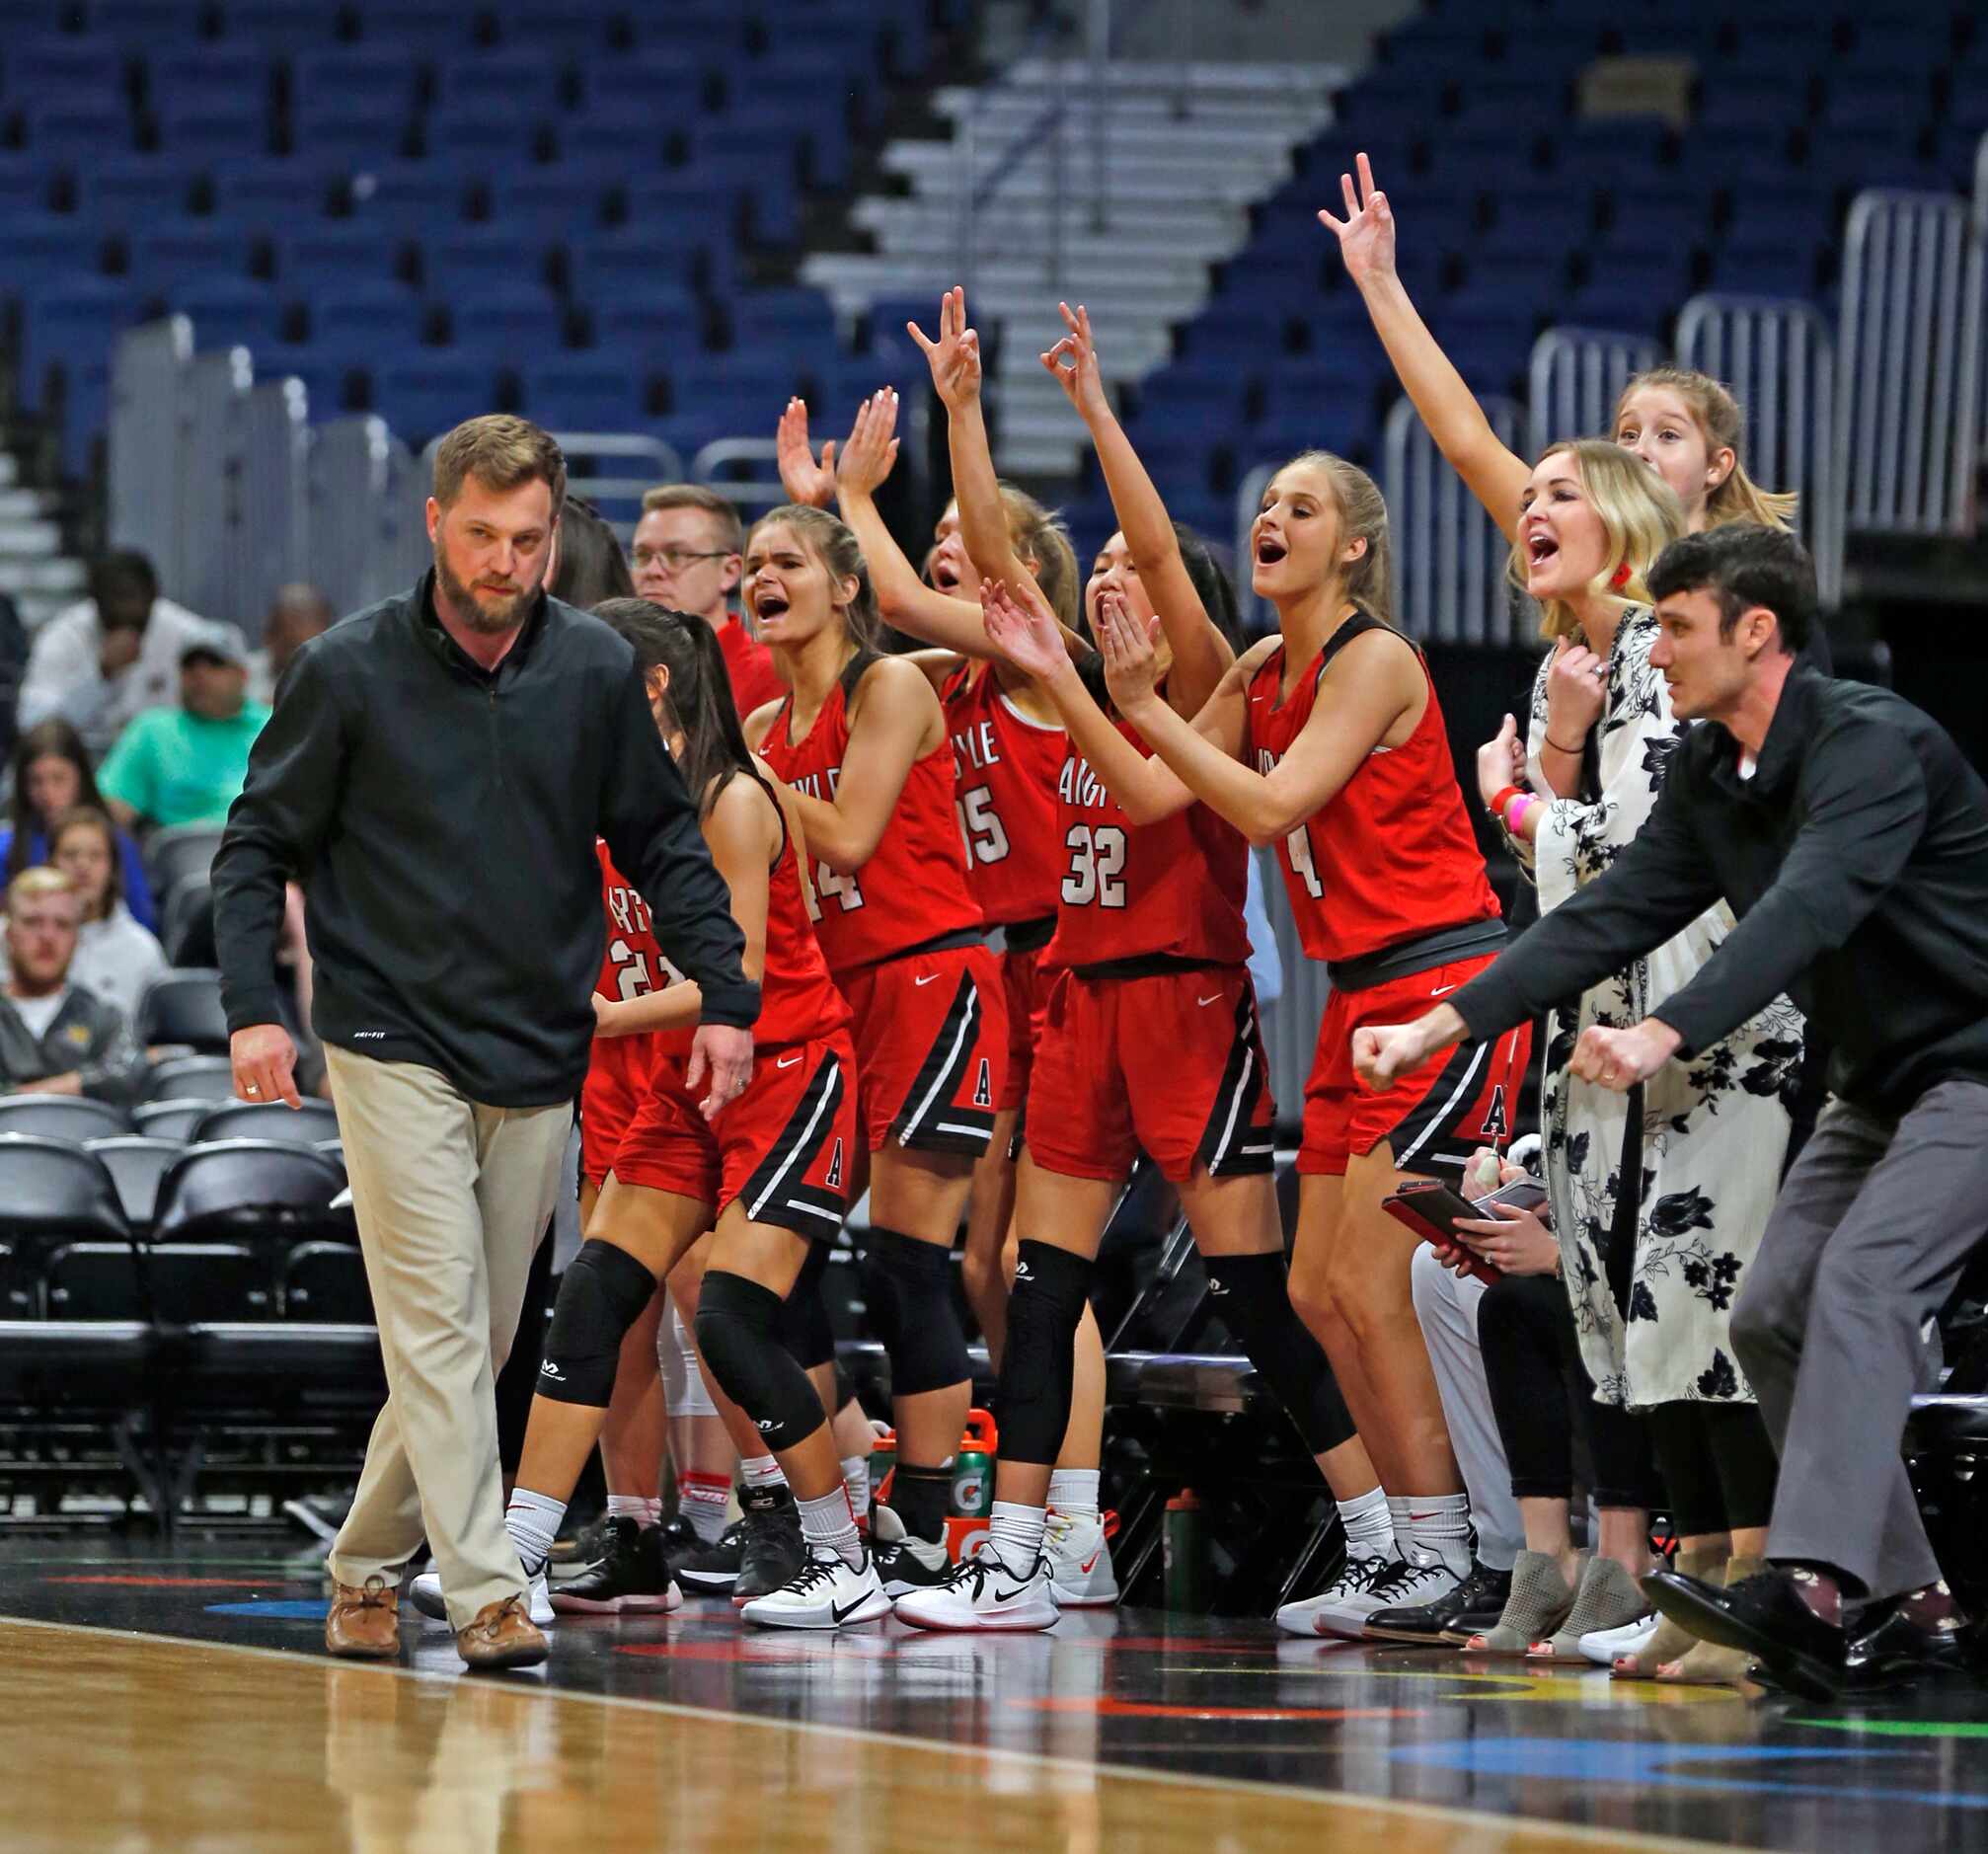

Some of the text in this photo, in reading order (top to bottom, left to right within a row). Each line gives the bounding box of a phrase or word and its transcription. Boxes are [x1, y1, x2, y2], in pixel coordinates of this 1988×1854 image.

[1061, 823, 1126, 908] 32
[972, 1057, 993, 1108] A
[1480, 1084, 1508, 1137] A
[825, 1136, 844, 1189] A
[954, 1468, 985, 1512] G
